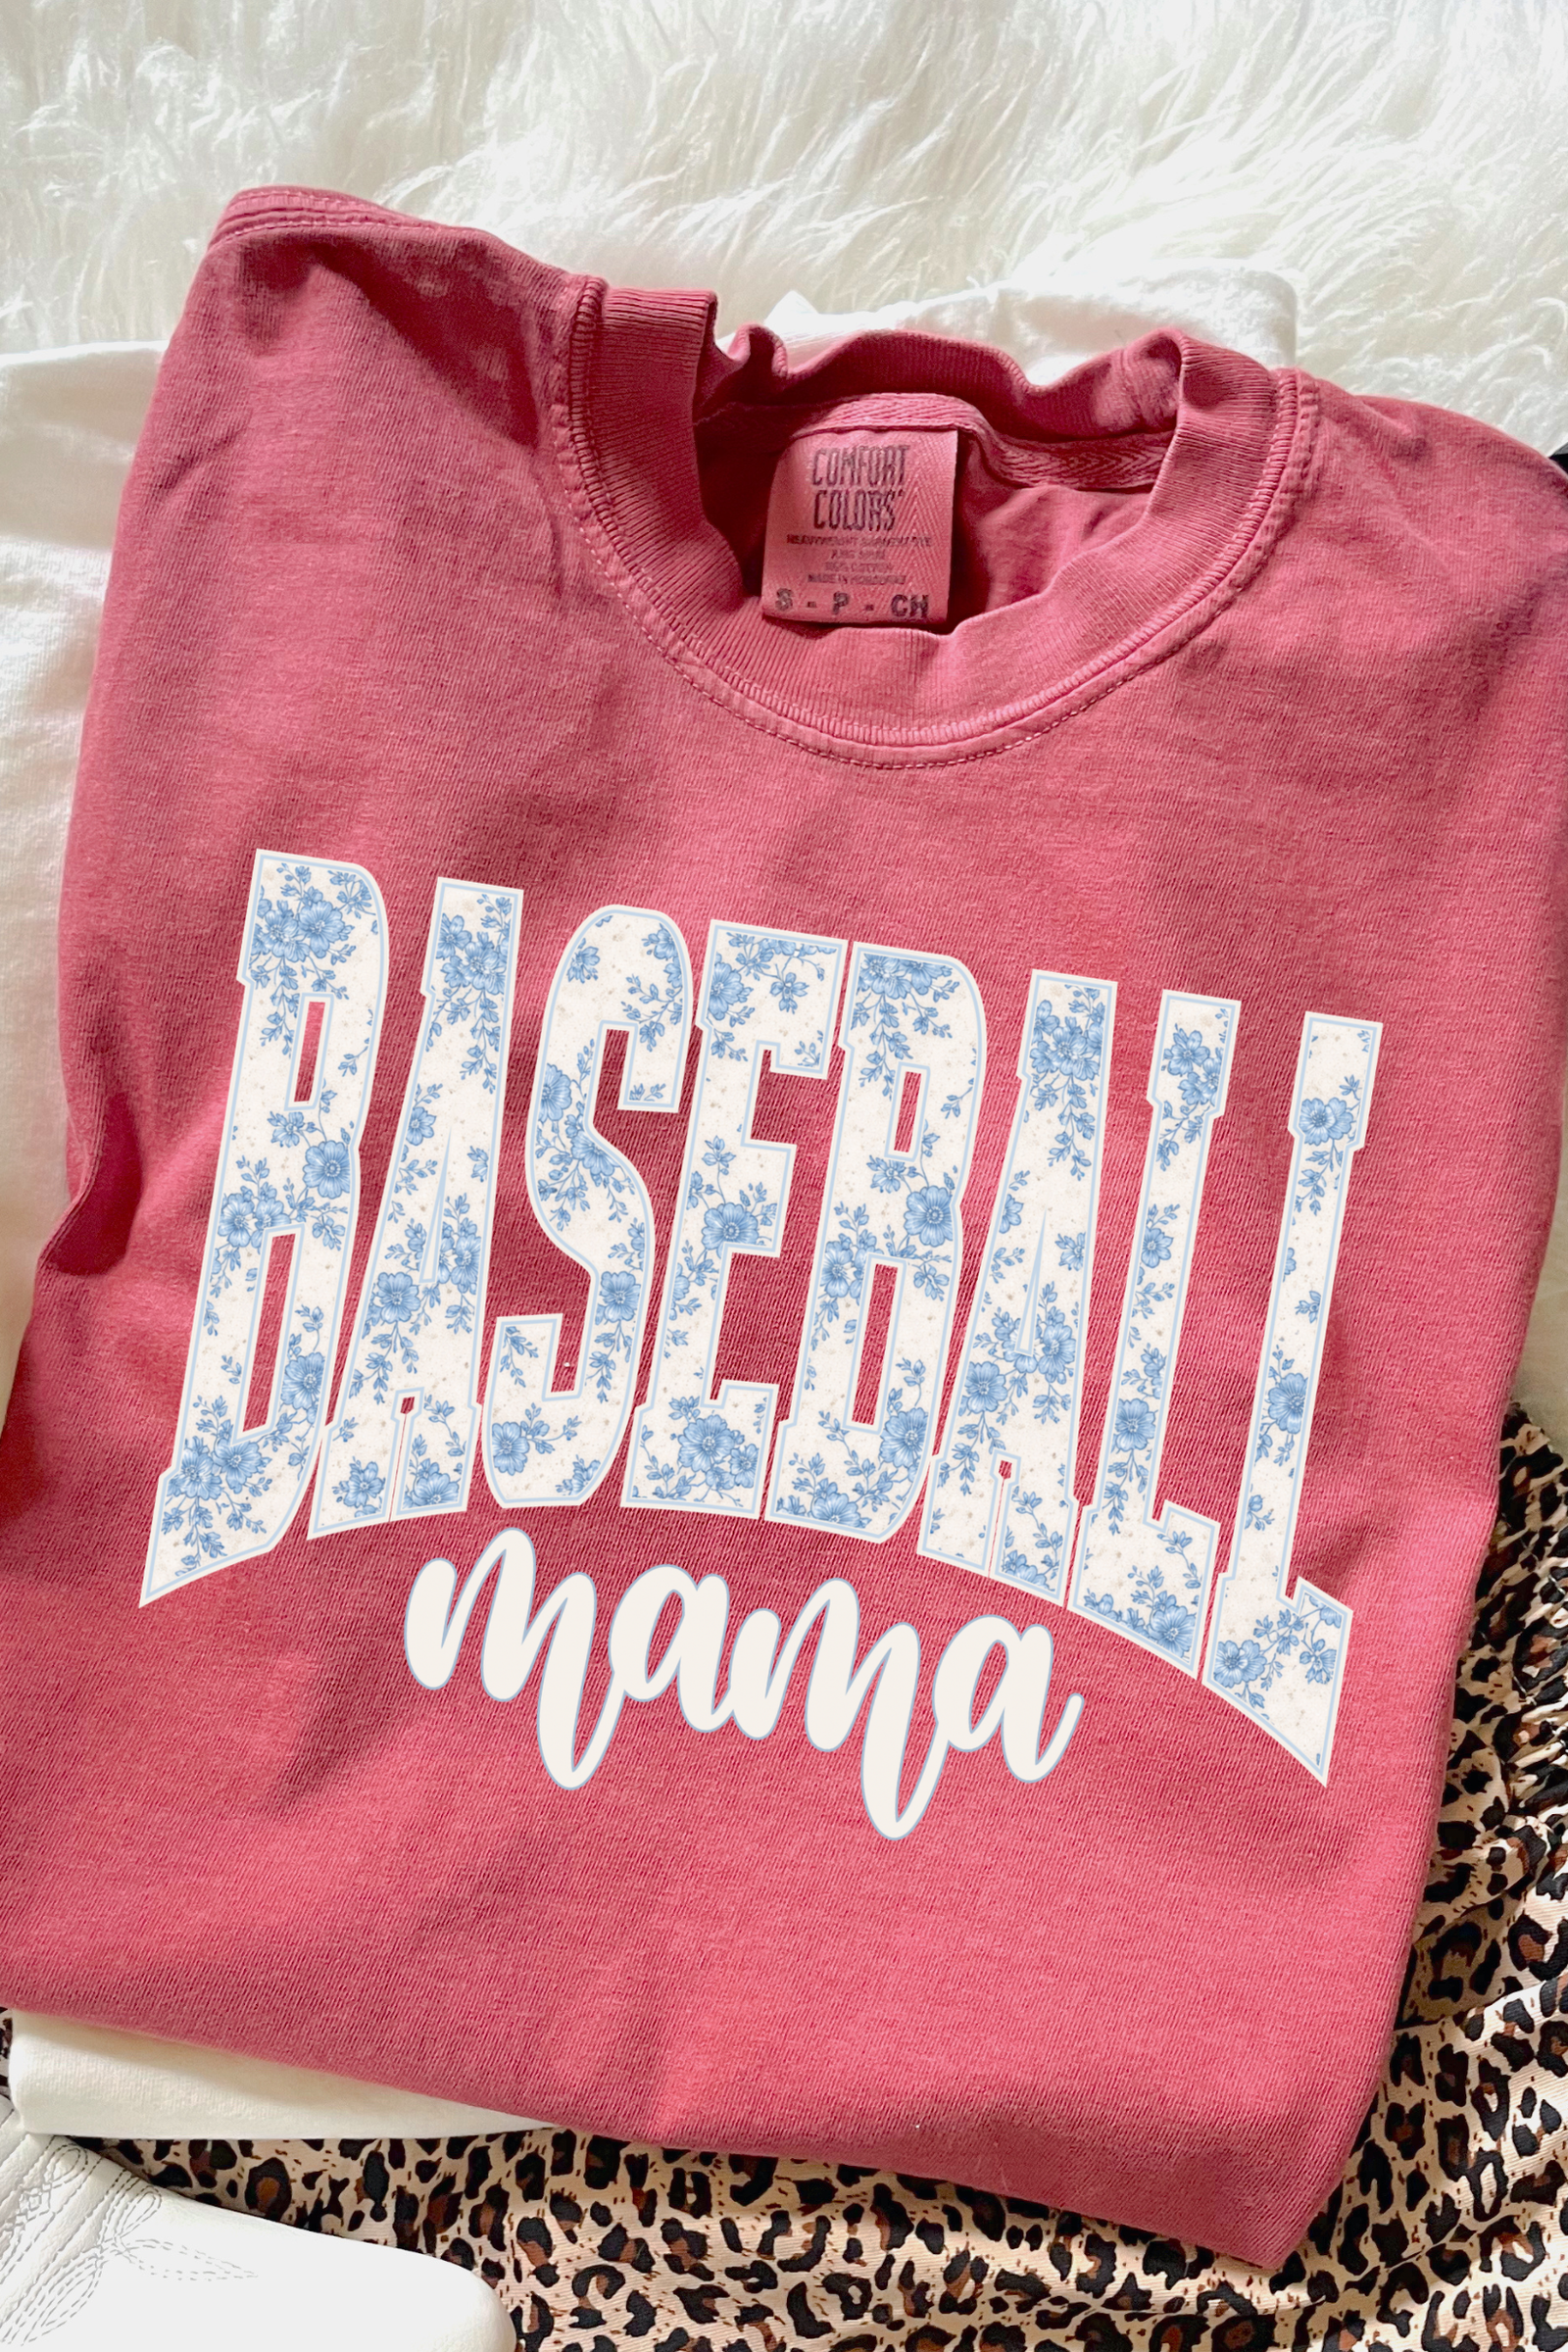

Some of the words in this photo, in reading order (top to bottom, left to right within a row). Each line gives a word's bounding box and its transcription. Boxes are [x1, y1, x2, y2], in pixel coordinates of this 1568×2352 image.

[812, 445, 909, 486] COMFORT
[775, 589, 794, 611] S
[833, 592, 850, 615] P
[890, 595, 930, 617] CH
[140, 850, 1382, 1786] BASEBALL
[405, 1529, 1085, 1840] mama
